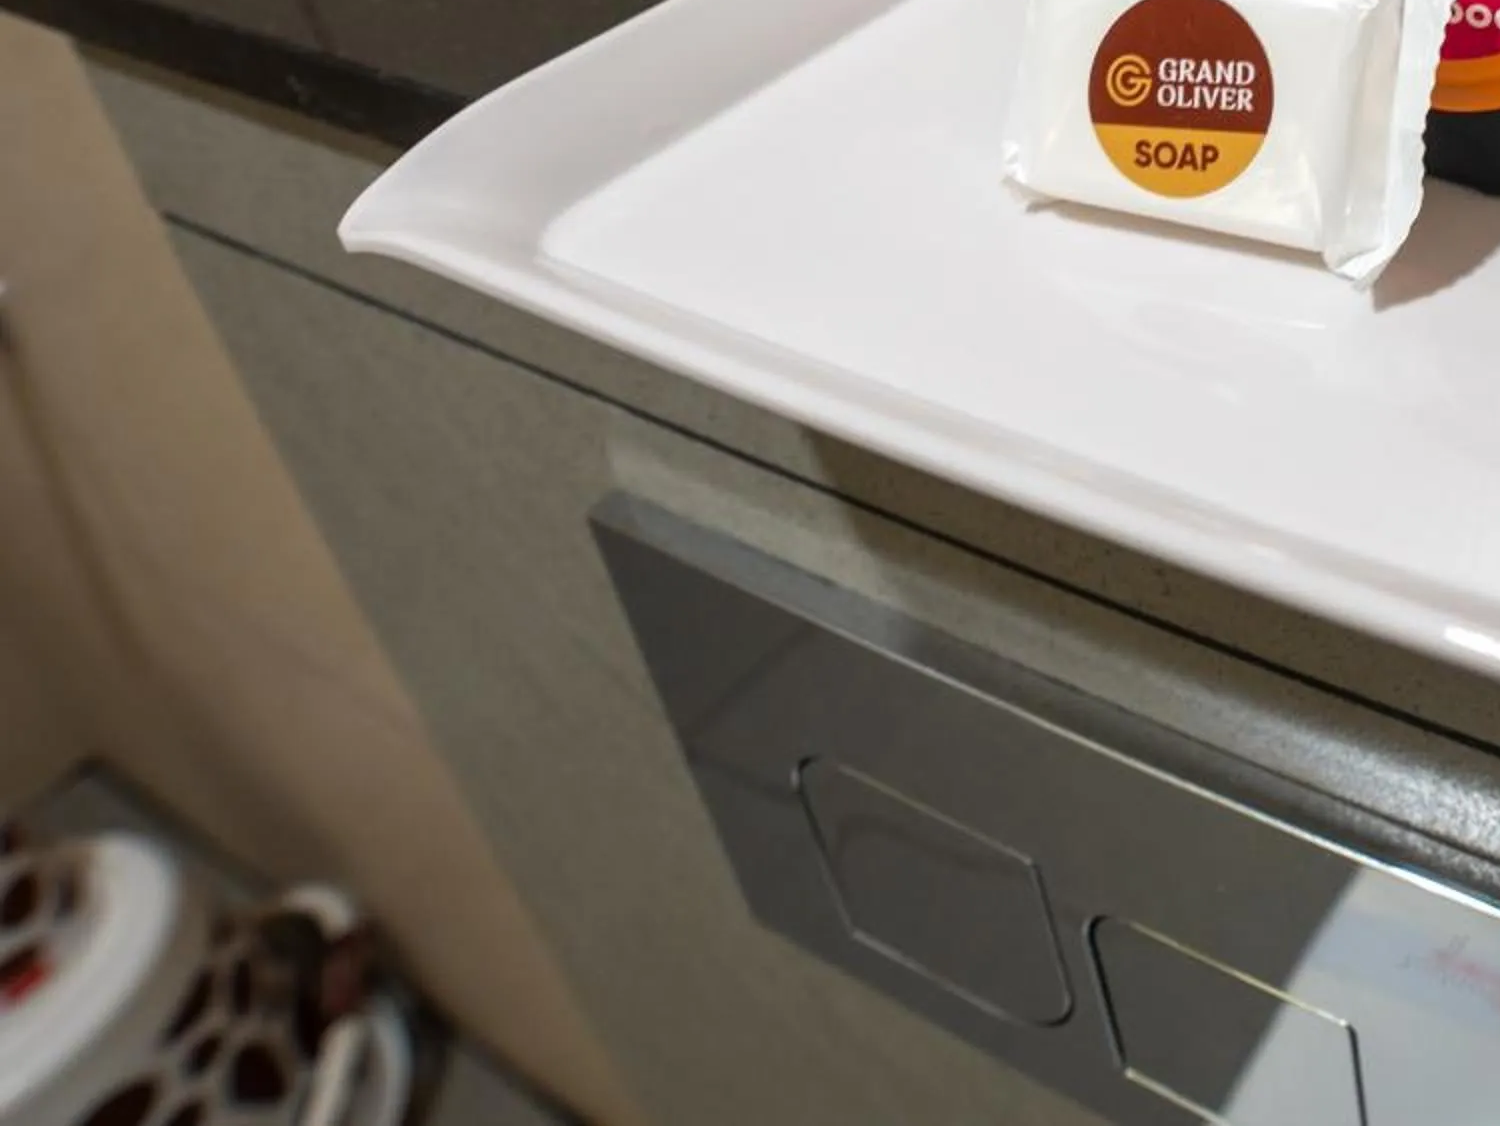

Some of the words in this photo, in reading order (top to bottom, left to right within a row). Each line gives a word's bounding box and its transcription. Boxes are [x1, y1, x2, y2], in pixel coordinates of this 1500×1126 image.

[1158, 58, 1255, 86] GRAND
[1157, 84, 1254, 112] OLIVER
[1133, 139, 1220, 172] SOAP
